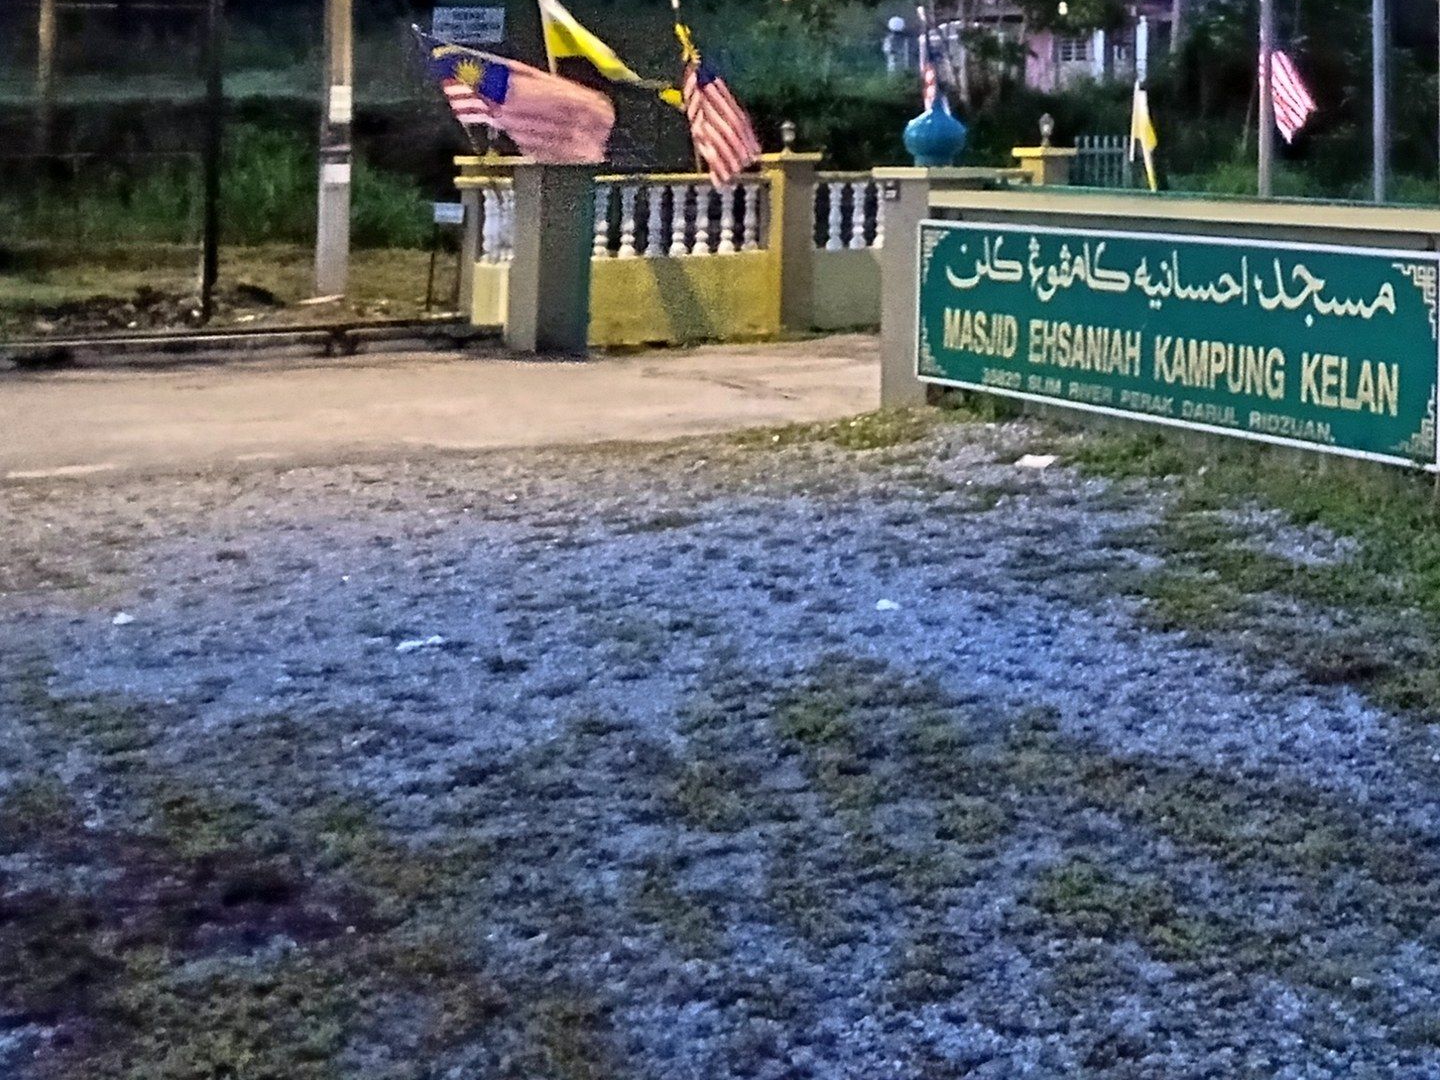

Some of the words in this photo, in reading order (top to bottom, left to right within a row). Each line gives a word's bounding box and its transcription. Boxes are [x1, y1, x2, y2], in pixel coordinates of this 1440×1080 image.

[1254, 257, 1396, 328] مسجد
[943, 307, 1019, 359] MASJID
[1028, 318, 1142, 378] EHSANIAH
[1154, 334, 1286, 401] KAMPUNG
[1300, 351, 1399, 418] KELAN
[1027, 374, 1062, 396] SLIM
[1068, 381, 1114, 405] RIVER
[1120, 388, 1175, 415] PERAK
[1181, 399, 1239, 427] DARUL
